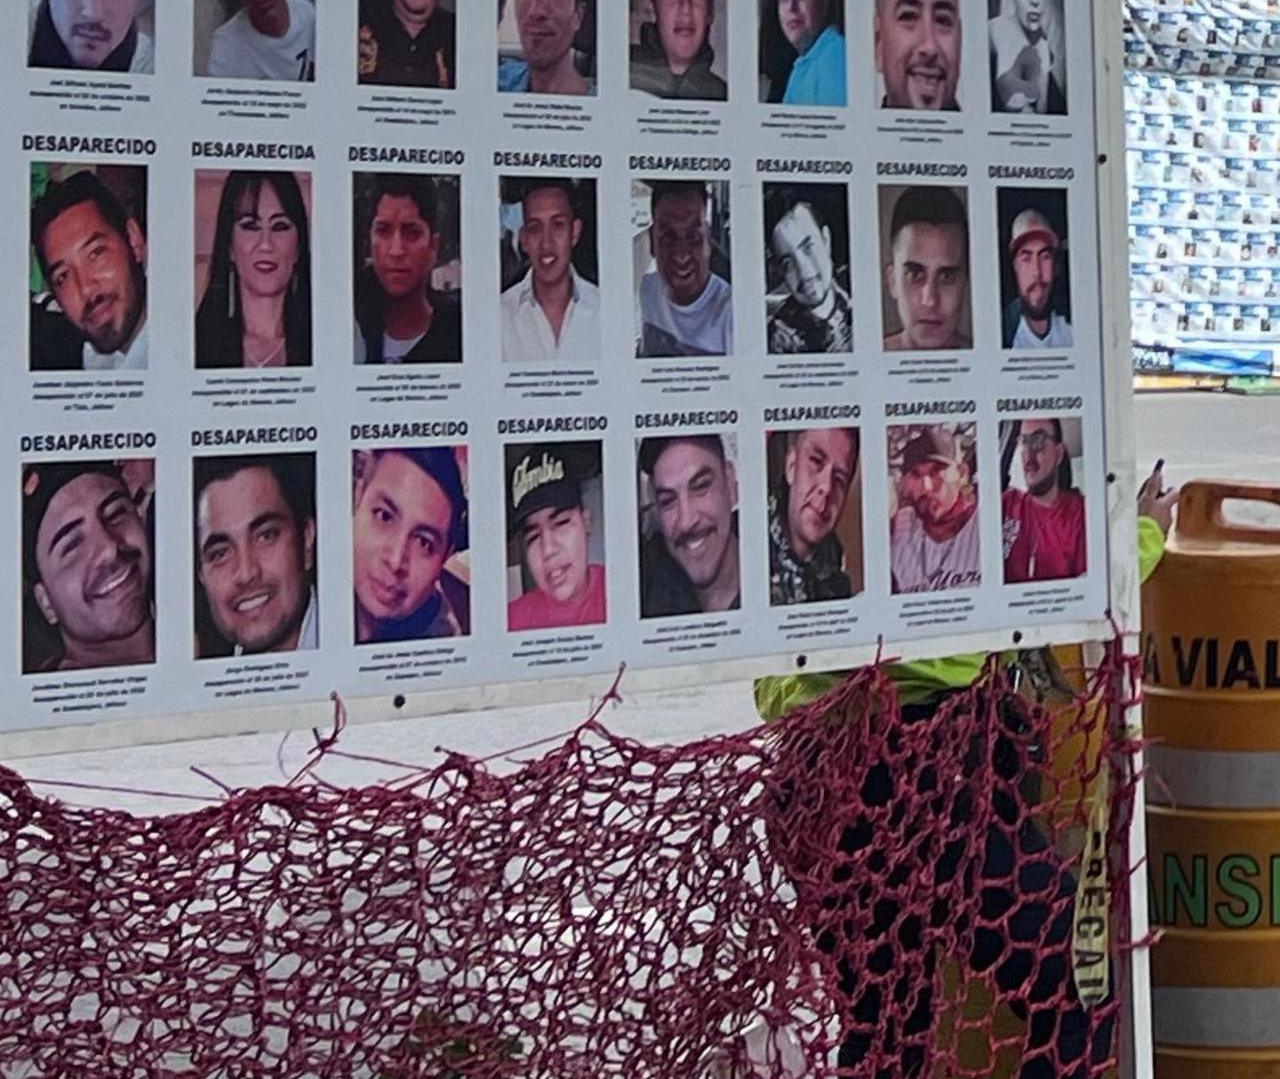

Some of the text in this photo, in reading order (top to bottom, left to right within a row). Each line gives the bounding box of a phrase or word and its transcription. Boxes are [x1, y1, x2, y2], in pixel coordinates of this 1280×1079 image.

[22, 133, 156, 156] DESAPARECIDO
[192, 141, 315, 161] DESAPARECIDA
[348, 146, 464, 166] DESAPARECIDO
[493, 150, 602, 170] DESAPARECIDO
[629, 154, 731, 173] DESAPARECIDO
[756, 158, 853, 176] DESAPARECIDO
[877, 161, 968, 178] DESAPARECIDO
[988, 165, 1075, 180] DESAPARECIDO
[764, 404, 861, 423] DESAPARECIDO
[885, 400, 977, 418] DESAPARECIDO
[996, 395, 1083, 413] DESAPARECIDO
[498, 414, 607, 435] DESAPARECIDO
[635, 410, 738, 430] DESAPARECIDO
[191, 426, 318, 447] DESAPARECIDO
[350, 420, 469, 441] DESAPARECIDO
[20, 430, 157, 452] DESAPARECIDO
